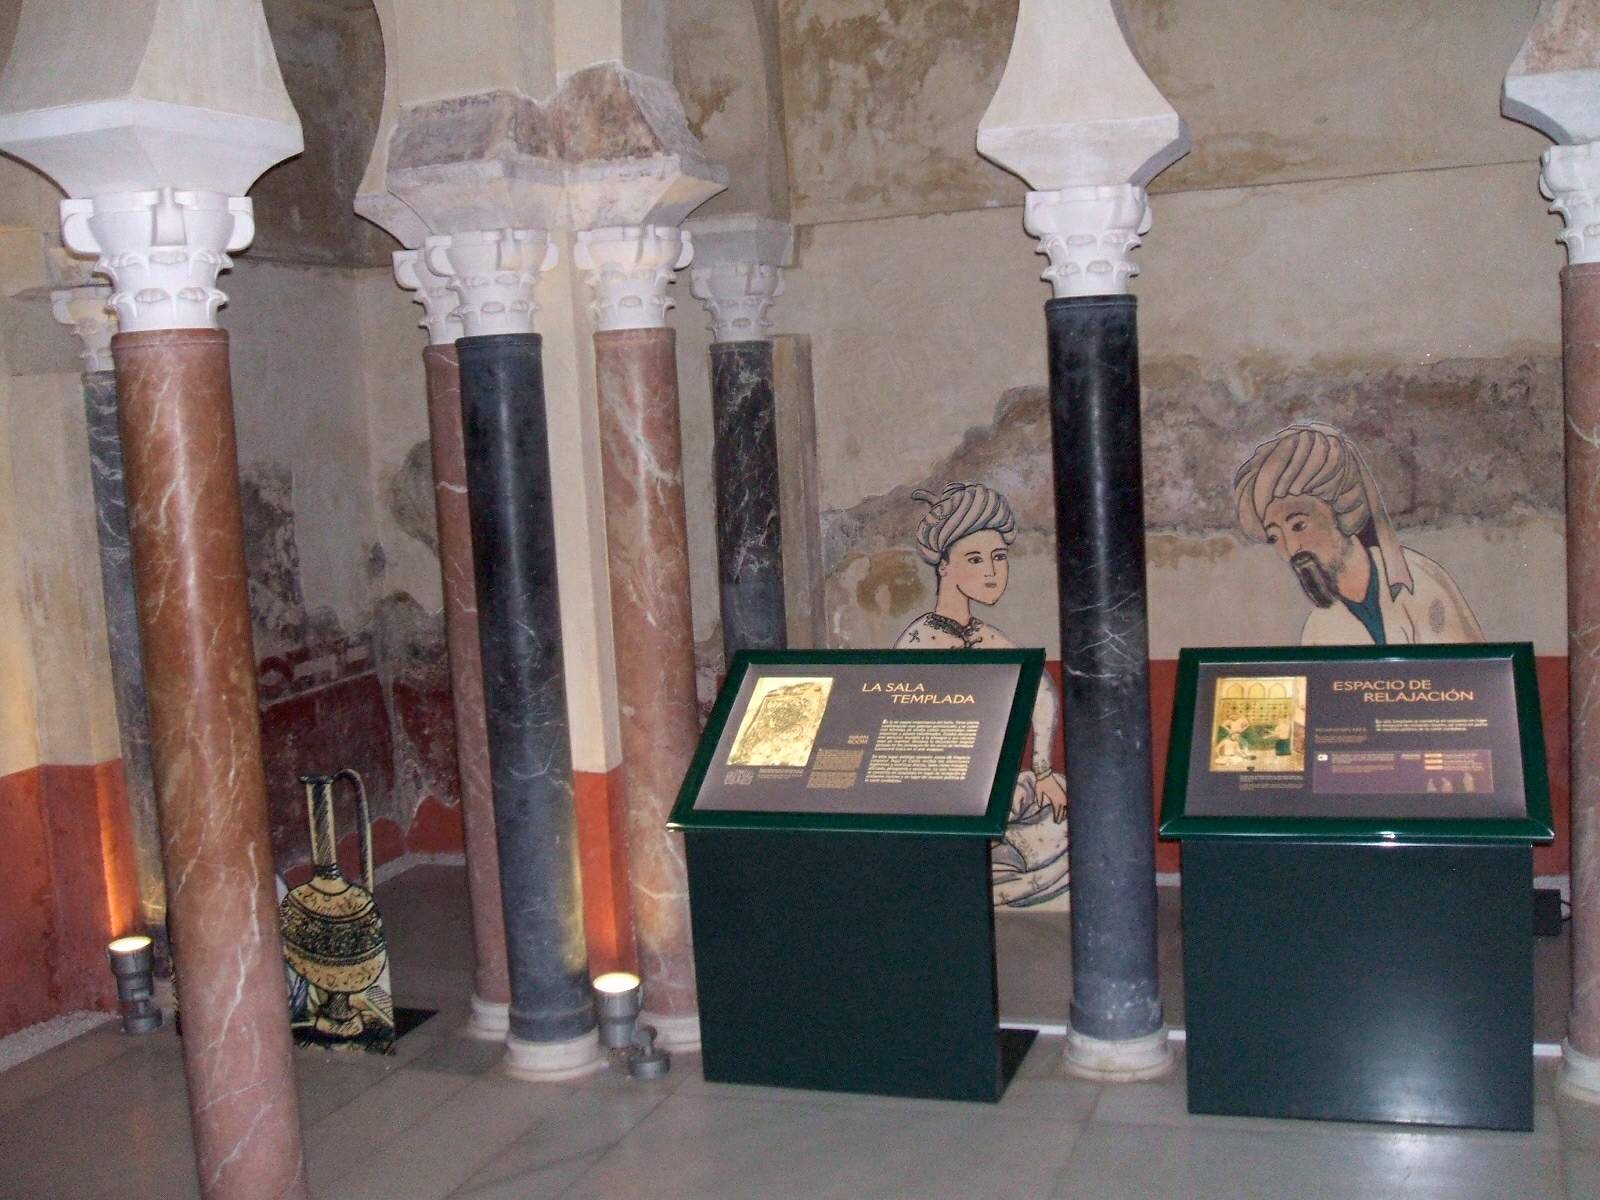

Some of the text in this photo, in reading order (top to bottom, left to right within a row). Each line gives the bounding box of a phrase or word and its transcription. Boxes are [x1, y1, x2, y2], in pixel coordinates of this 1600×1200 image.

[862, 683, 925, 692] LA SALA
[1333, 680, 1431, 691] ESPACIO DE
[891, 694, 975, 704] TEMPLADA
[1364, 689, 1474, 702] RELAJACIÓN
